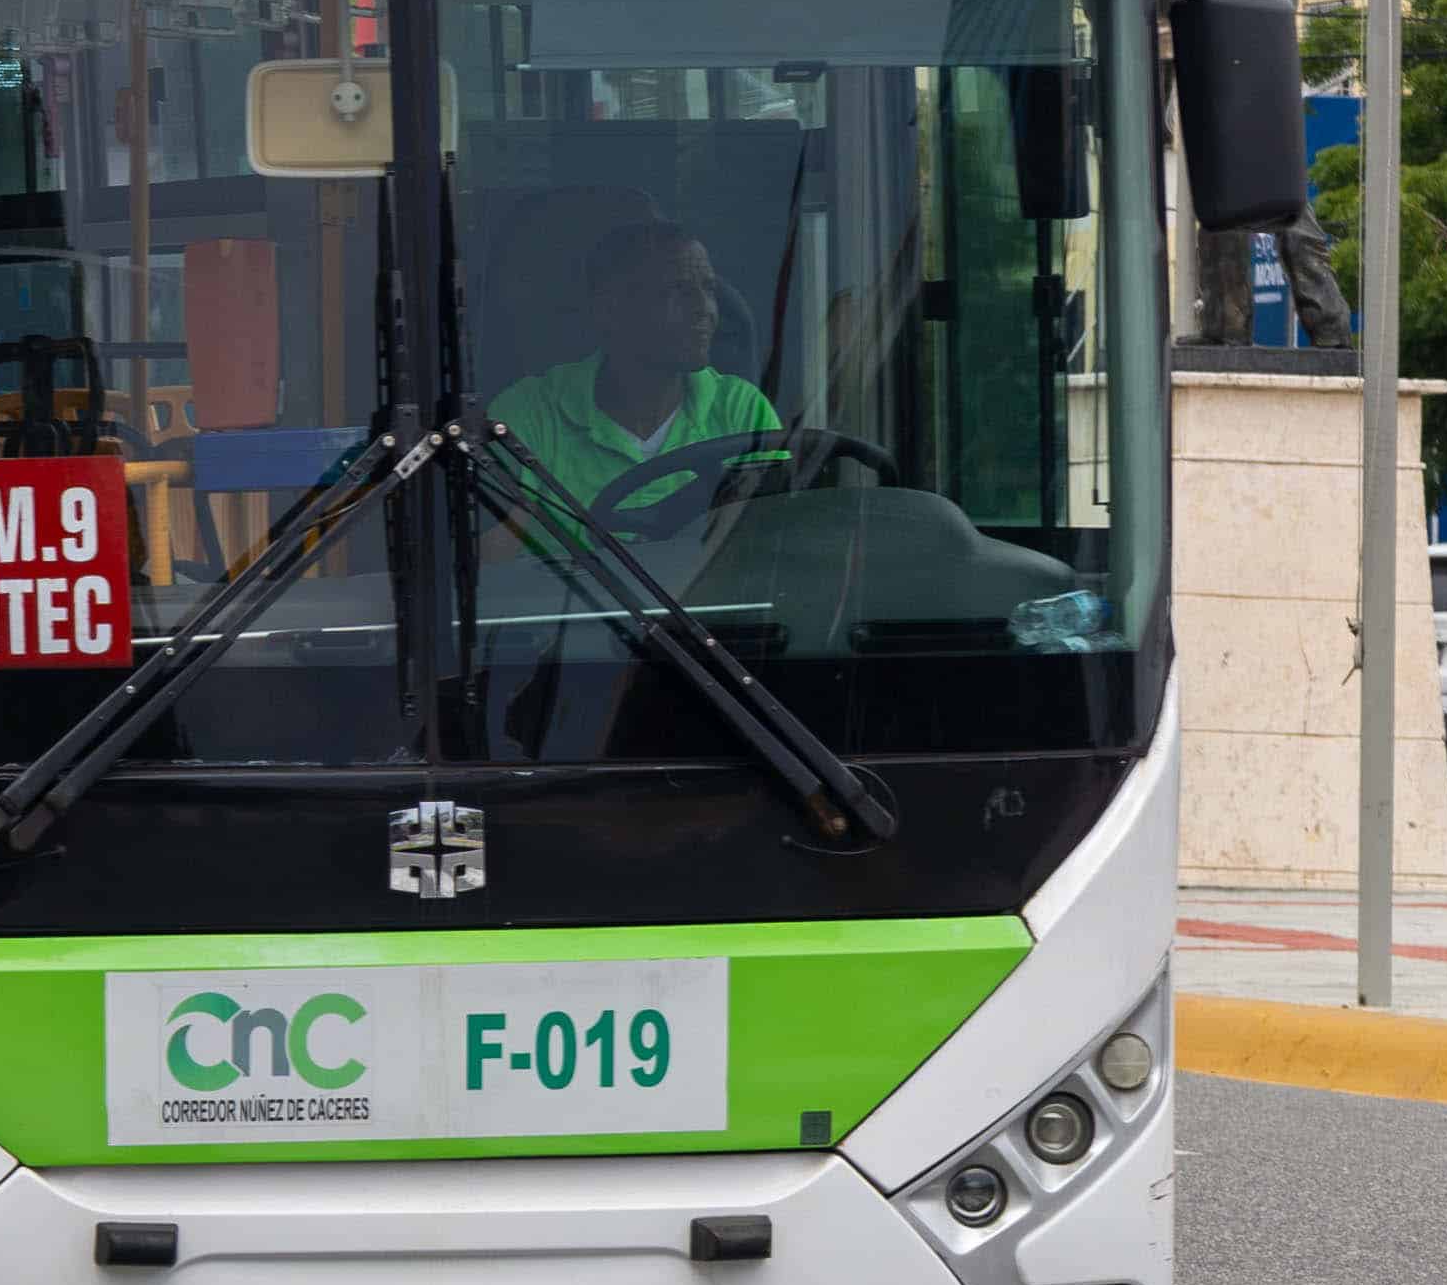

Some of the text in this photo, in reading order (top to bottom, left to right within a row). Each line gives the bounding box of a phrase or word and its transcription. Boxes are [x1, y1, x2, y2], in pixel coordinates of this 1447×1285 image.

[465, 1008, 672, 1091] F-019
[162, 1100, 237, 1123] CORREDOR
[286, 1099, 305, 1122] DE
